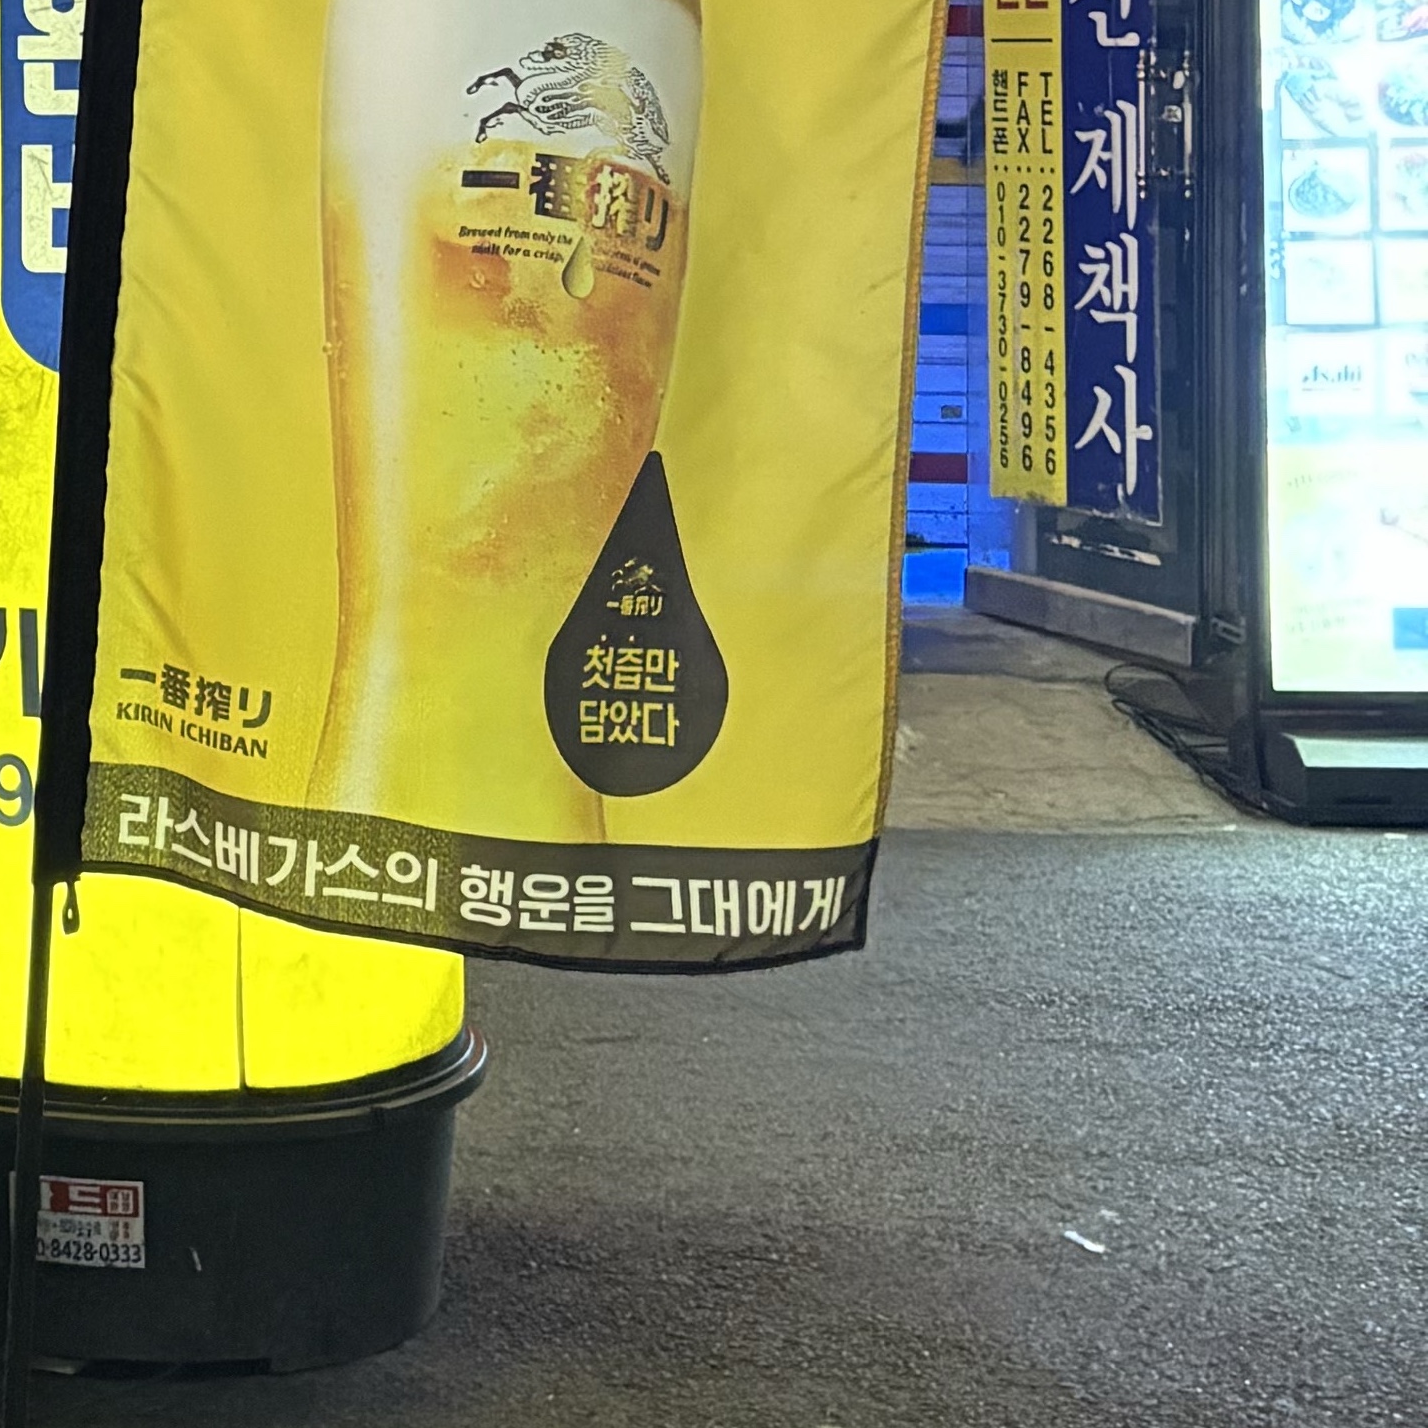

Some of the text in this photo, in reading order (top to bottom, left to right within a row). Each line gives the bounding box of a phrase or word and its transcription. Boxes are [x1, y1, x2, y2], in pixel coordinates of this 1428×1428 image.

[118, 663, 273, 730] 一番搾り
[580, 644, 681, 694] 첫즙만
[116, 701, 269, 761] KIRIN ICHIBAN
[578, 699, 681, 747] 담았다
[116, 791, 847, 939] 라스베가스의 행운을 그대에게
